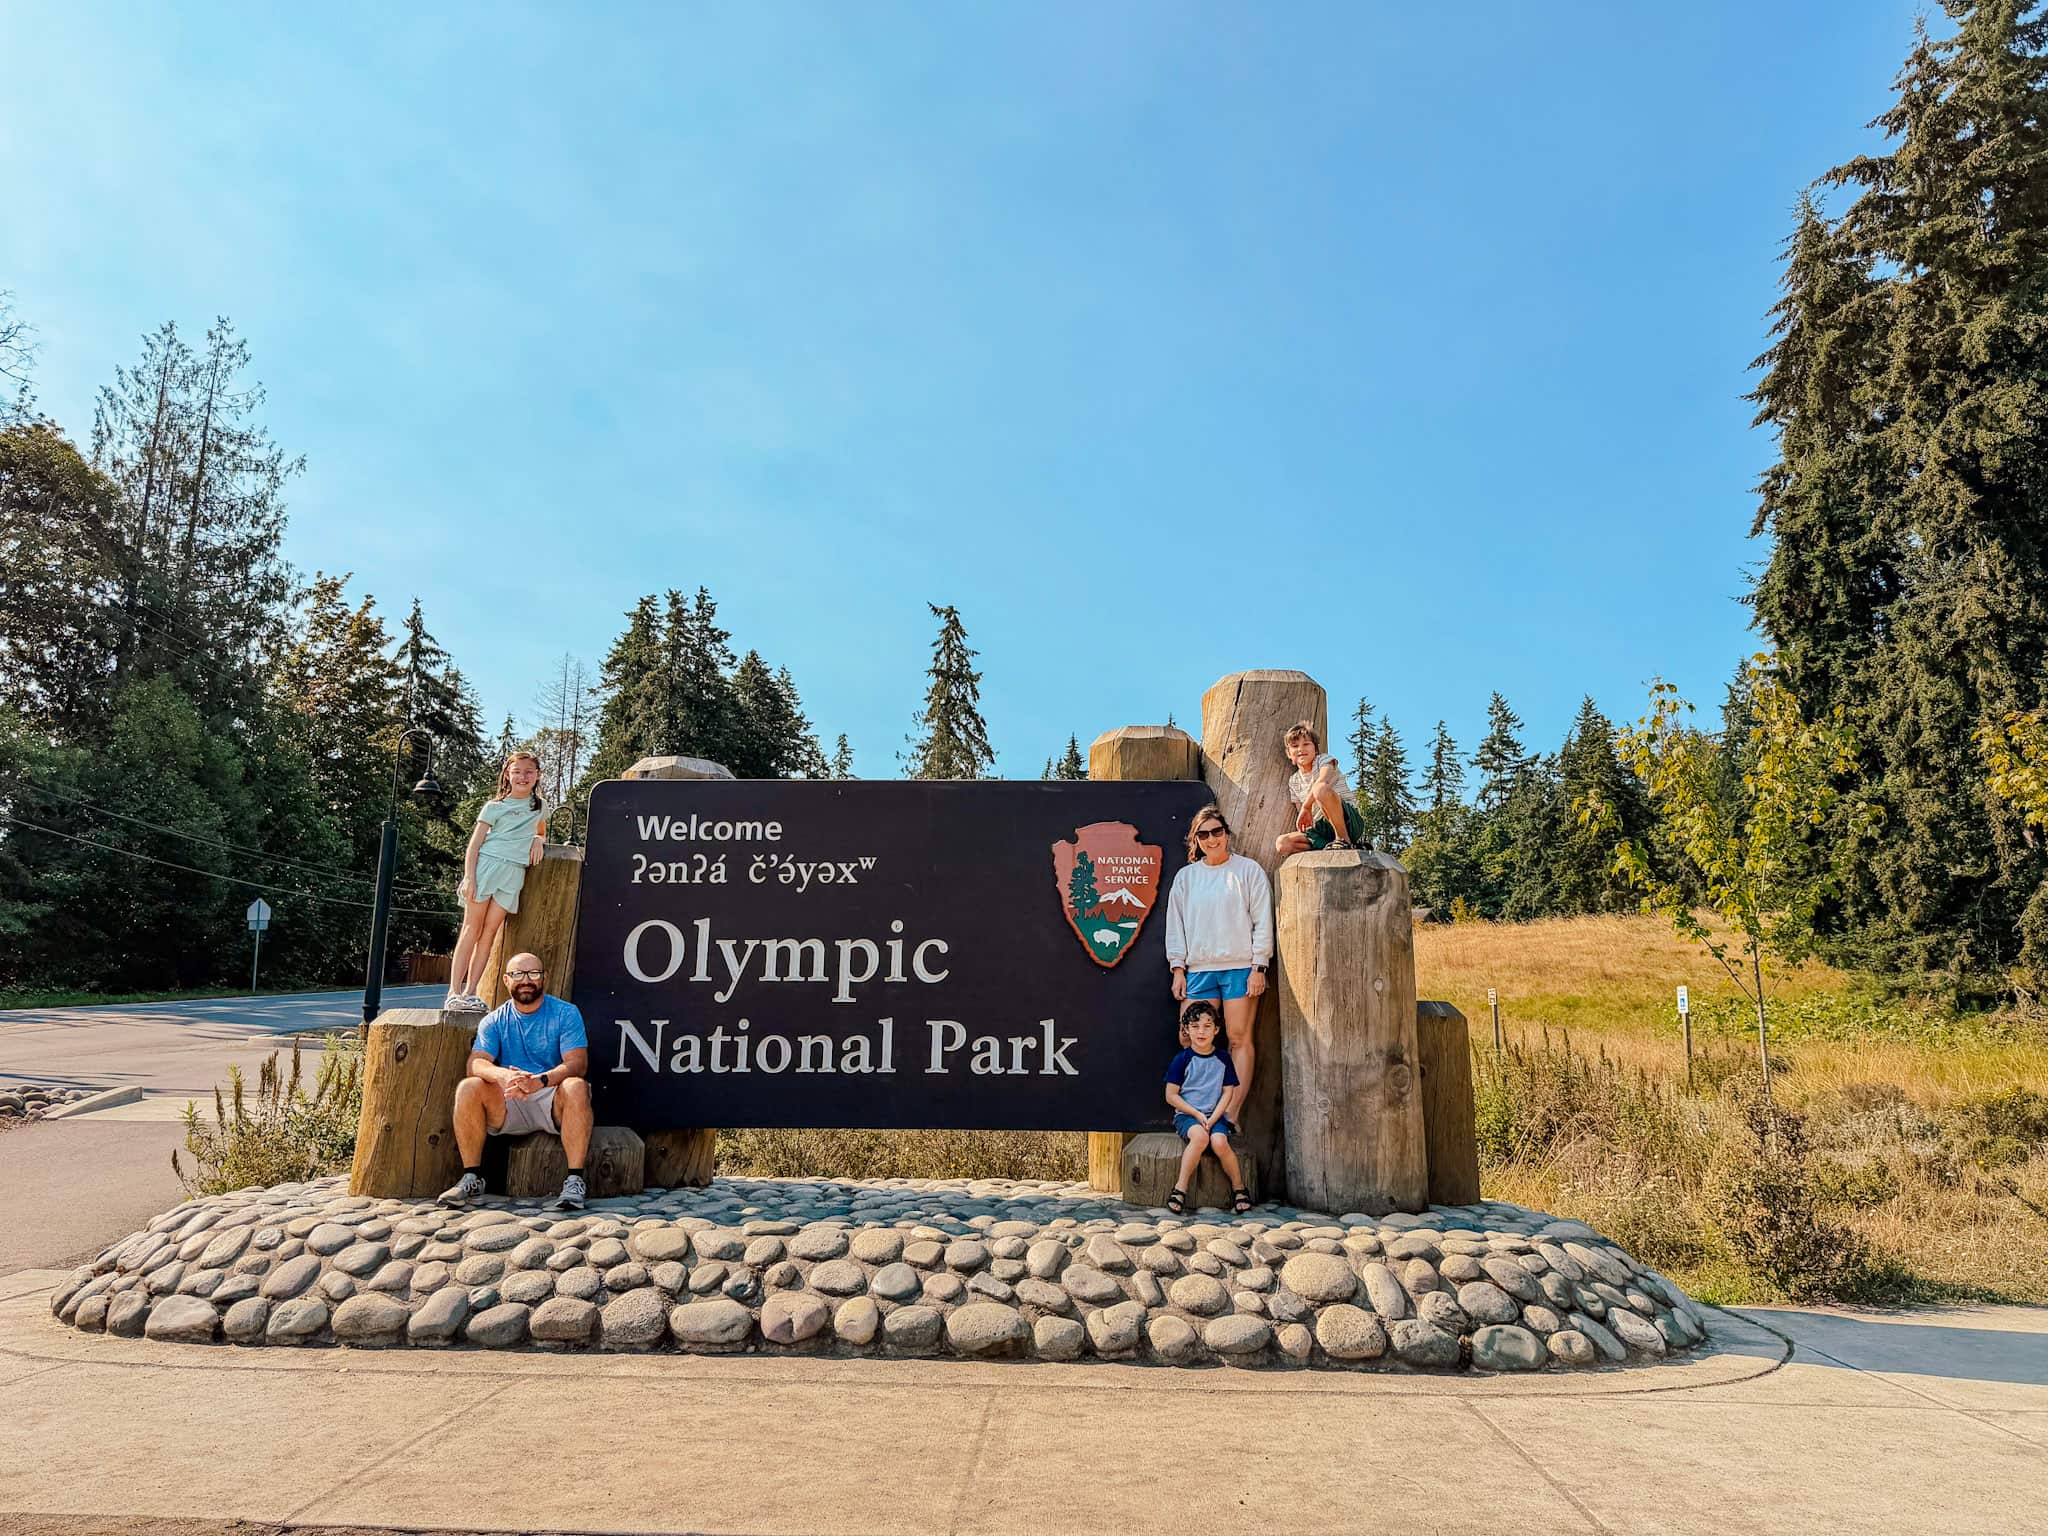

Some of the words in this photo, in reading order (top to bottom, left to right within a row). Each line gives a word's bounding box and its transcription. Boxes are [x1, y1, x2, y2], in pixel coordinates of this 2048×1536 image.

[636, 813, 784, 841] Welcome
[1097, 856, 1156, 865] NATIONAL
[1111, 865, 1142, 874] PARK
[1103, 875, 1149, 884] SERVICE
[622, 917, 949, 1003] Olympic
[610, 1017, 897, 1074] National
[924, 1018, 1080, 1076] Park
